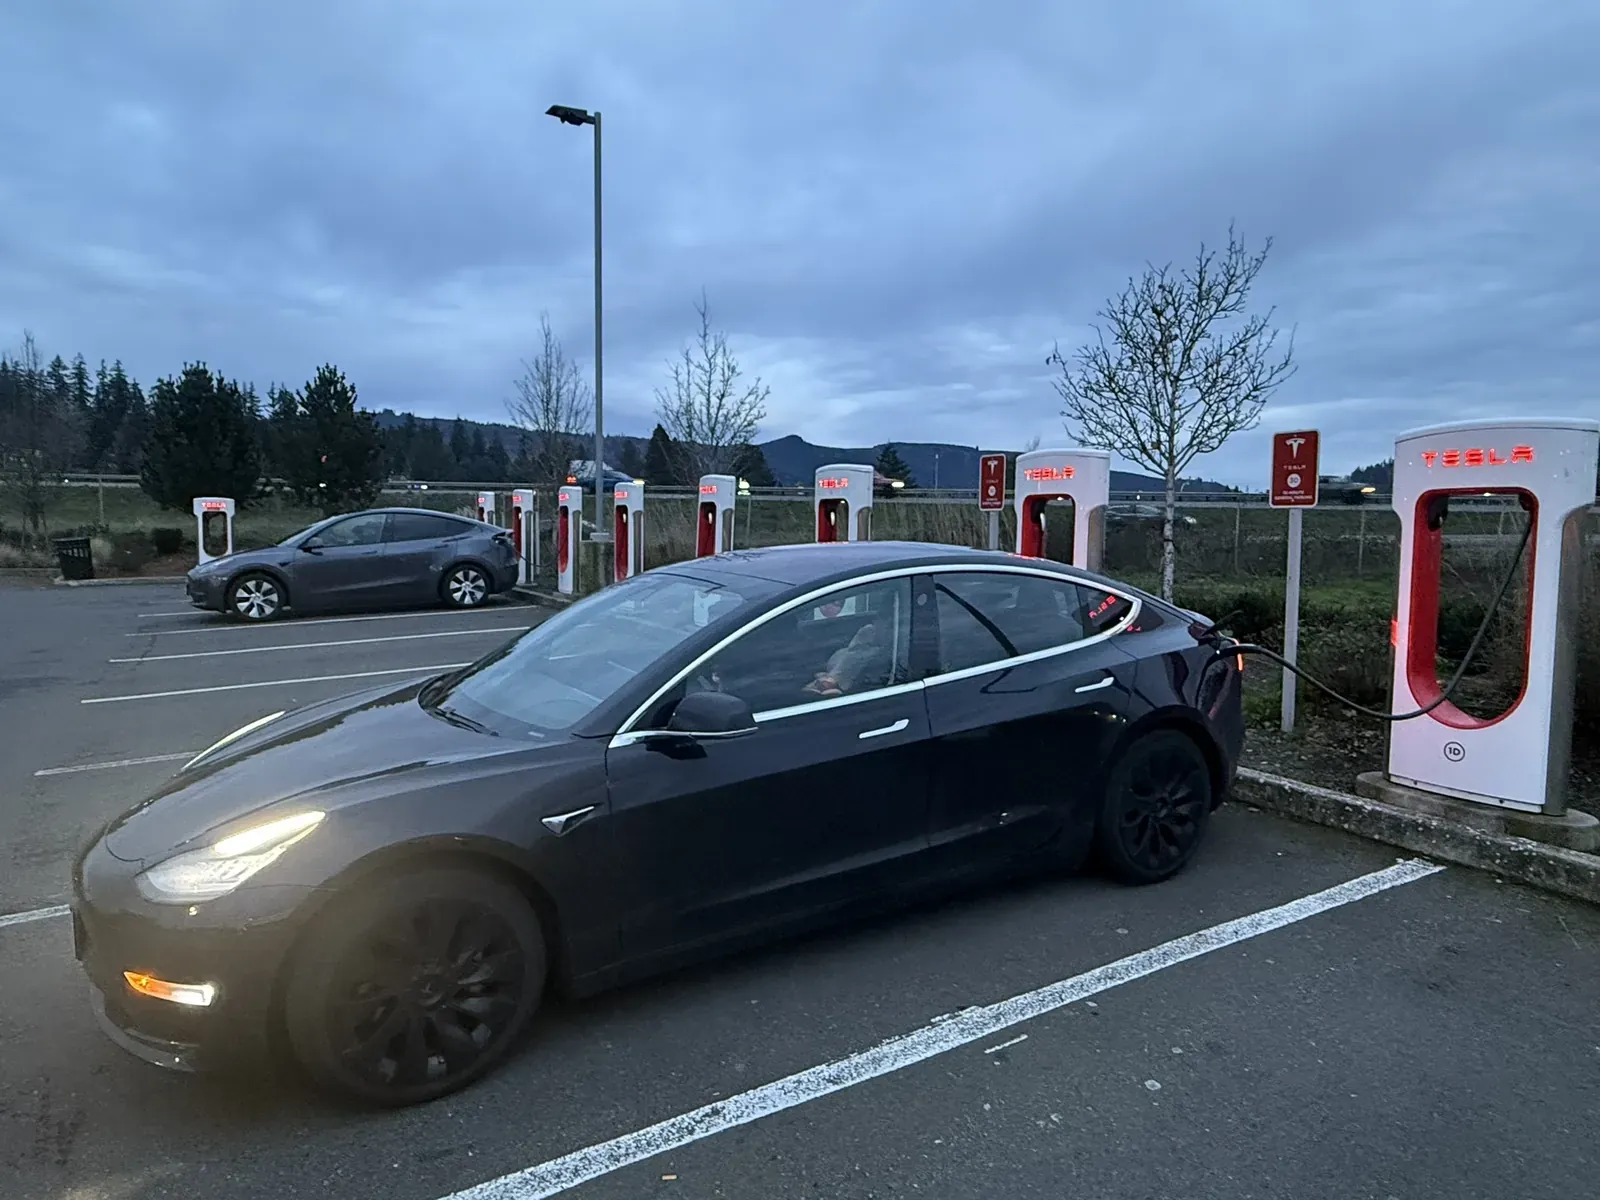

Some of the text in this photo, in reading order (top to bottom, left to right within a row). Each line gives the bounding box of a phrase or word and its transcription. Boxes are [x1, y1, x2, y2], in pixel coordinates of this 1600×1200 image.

[1421, 445, 1535, 468] TESLA
[1024, 465, 1076, 480] TESLA
[818, 477, 849, 488] TESLA
[1448, 746, 1461, 756] 1D
